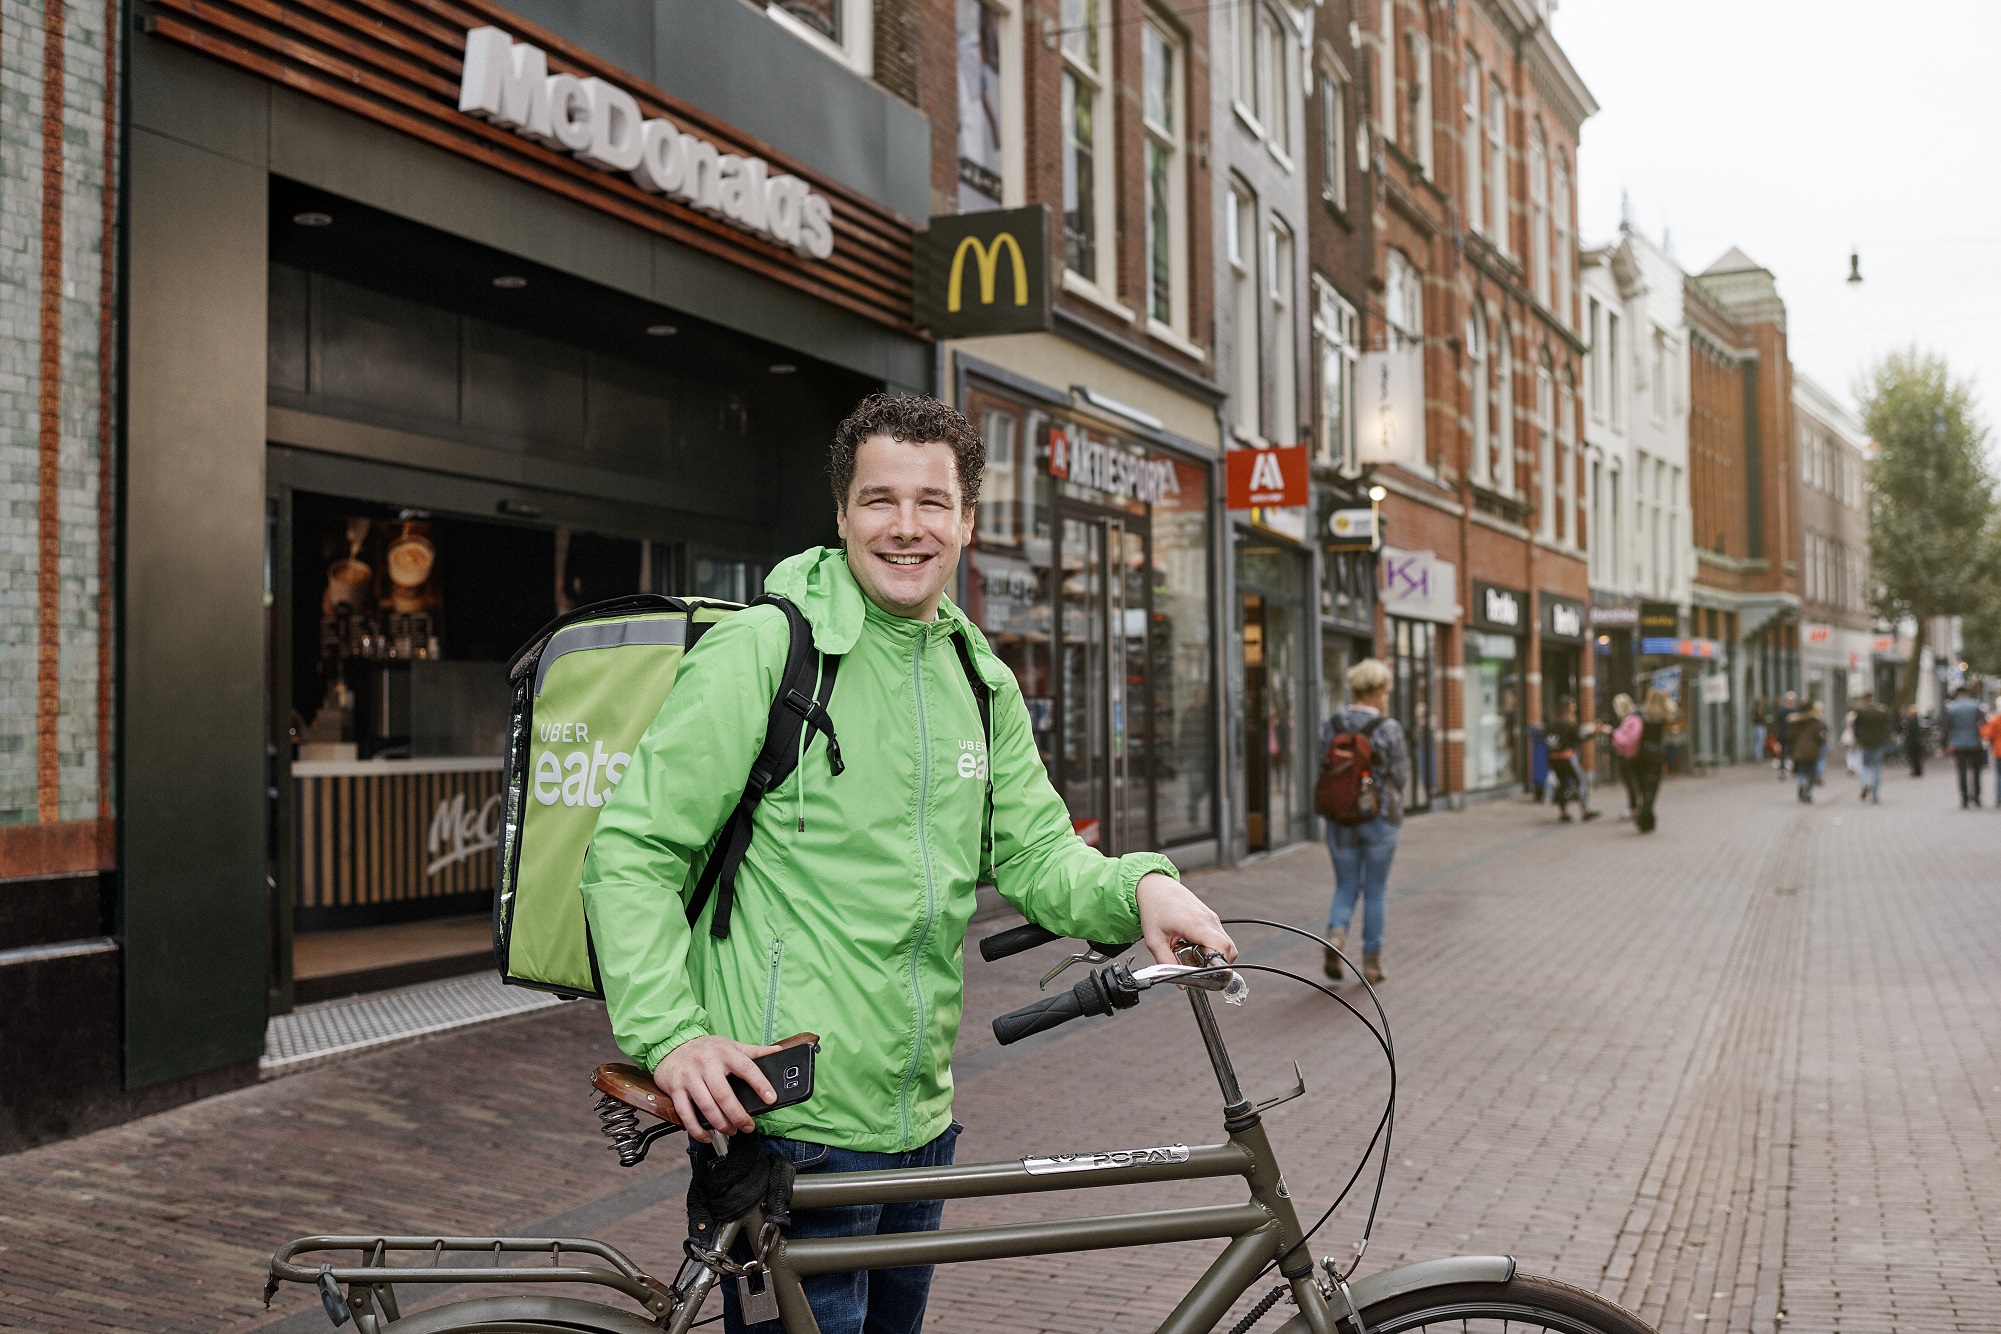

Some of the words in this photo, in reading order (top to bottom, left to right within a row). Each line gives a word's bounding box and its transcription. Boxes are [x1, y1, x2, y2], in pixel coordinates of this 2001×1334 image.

[459, 25, 834, 260] McDonald's
[540, 722, 590, 743] UBER
[958, 739, 988, 752] UBER
[534, 740, 632, 808] eats
[957, 752, 989, 781] ea
[1093, 1149, 1183, 1167] POPAL
